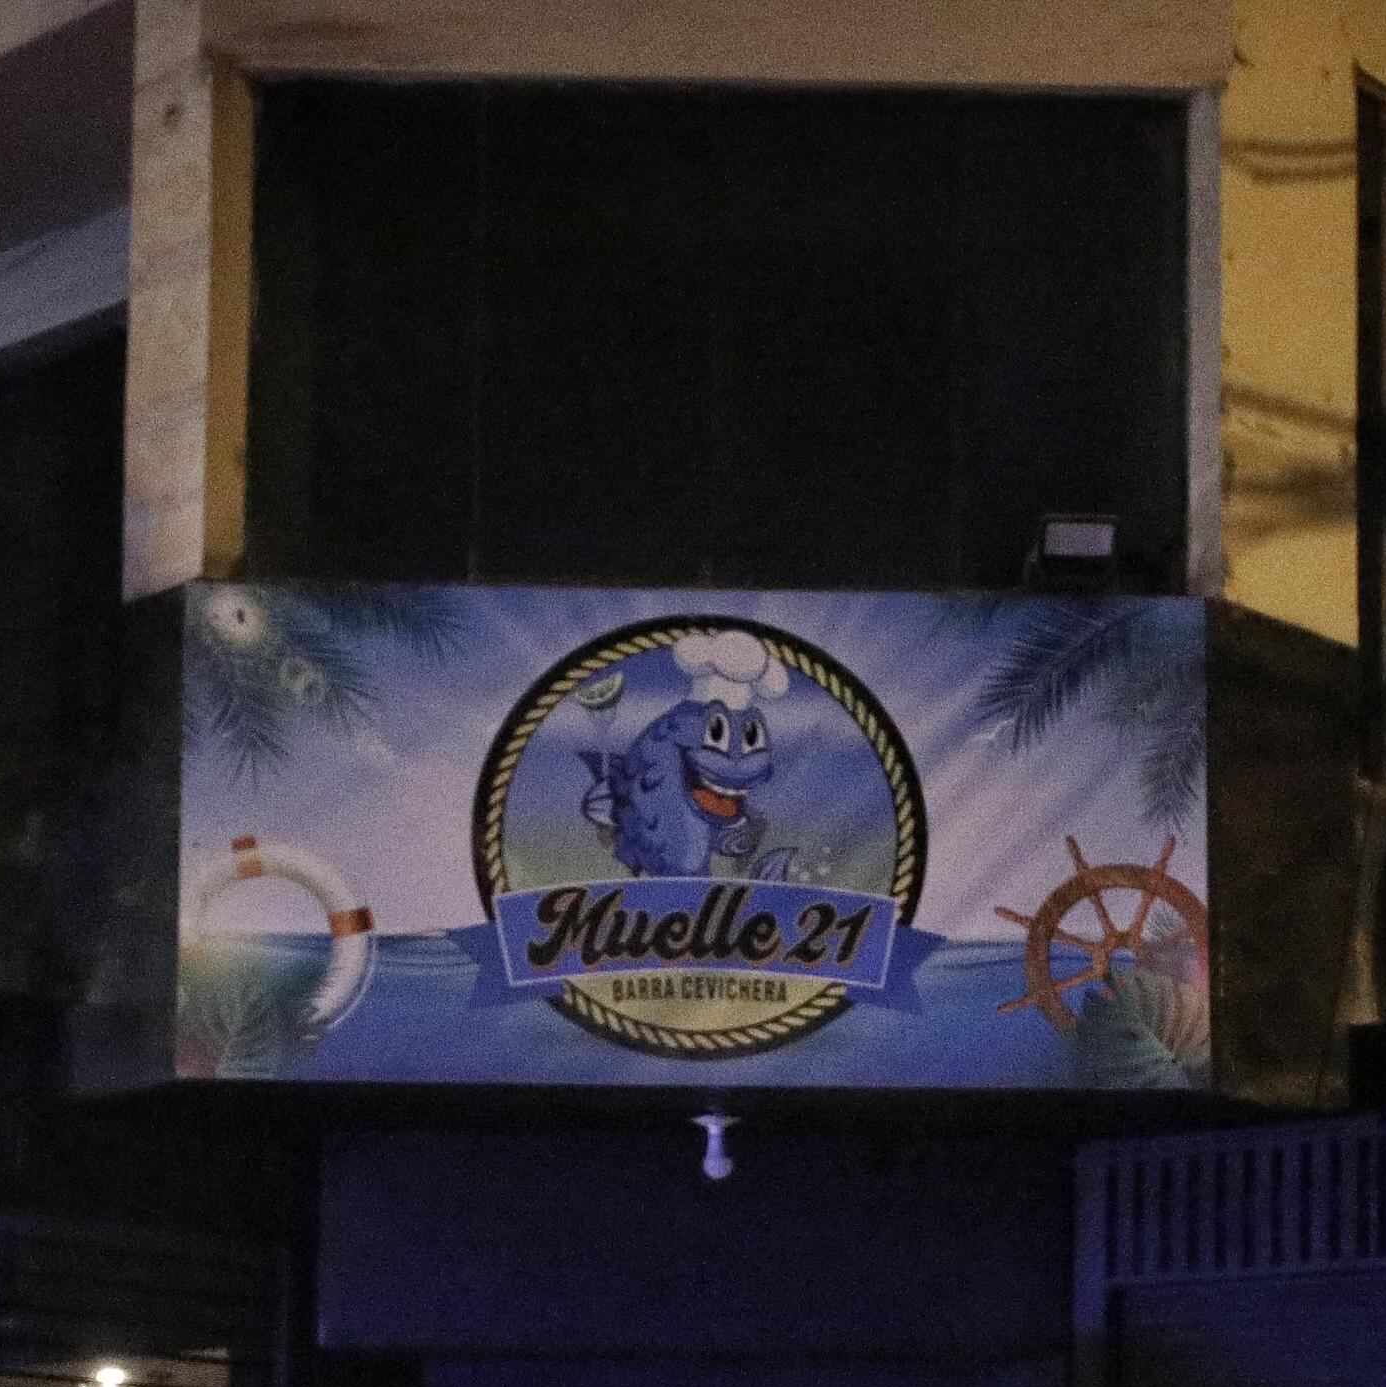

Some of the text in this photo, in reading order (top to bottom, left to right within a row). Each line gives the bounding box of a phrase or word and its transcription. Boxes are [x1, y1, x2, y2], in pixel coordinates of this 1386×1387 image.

[527, 884, 875, 968] Muelle 21
[613, 976, 788, 1002] BARRA CEVICHERA
